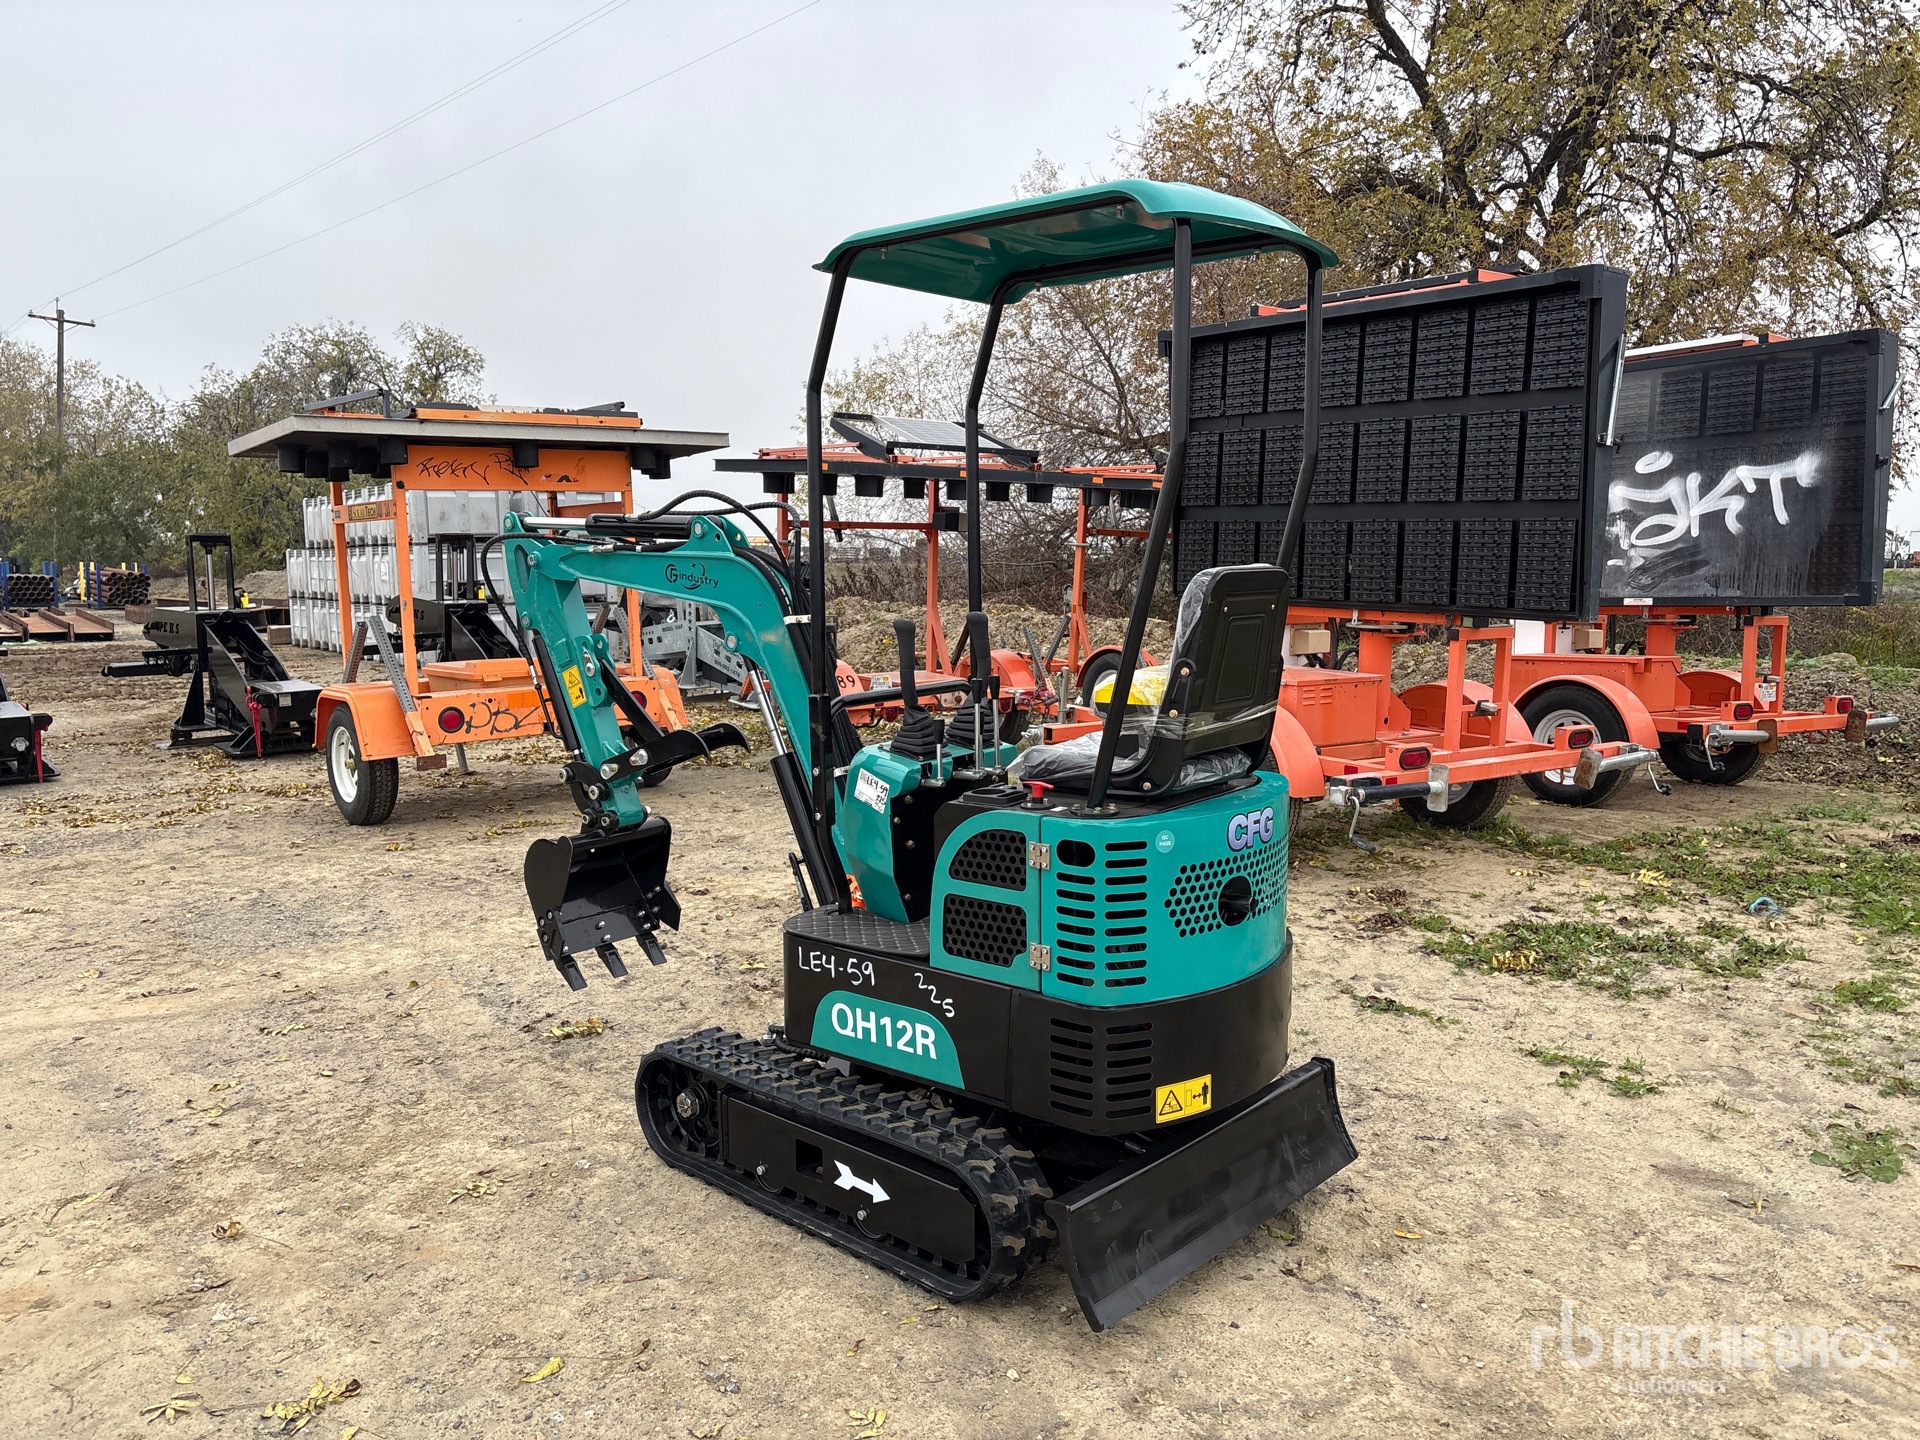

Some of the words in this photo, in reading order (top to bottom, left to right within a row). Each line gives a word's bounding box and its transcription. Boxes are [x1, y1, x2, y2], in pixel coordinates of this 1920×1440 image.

[1227, 806, 1274, 852] CFG
[798, 946, 875, 986] LE4-59
[831, 1002, 937, 1060] QH12R
